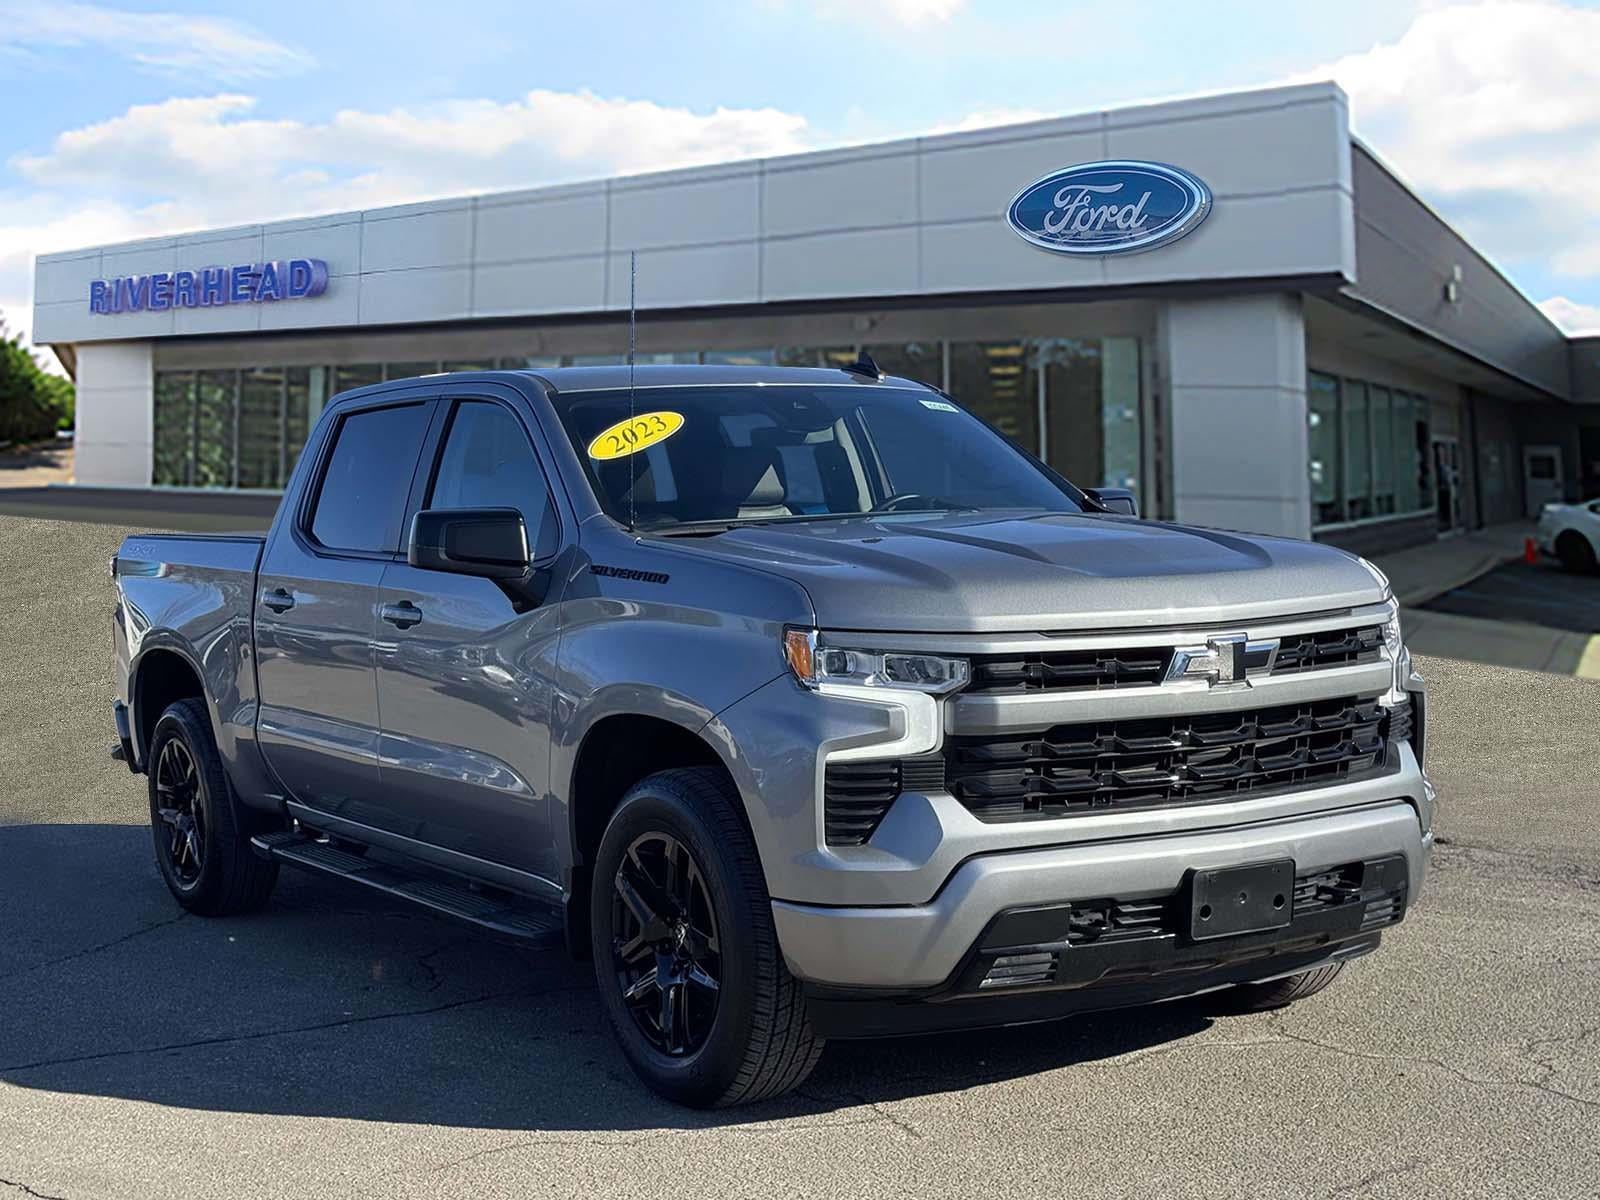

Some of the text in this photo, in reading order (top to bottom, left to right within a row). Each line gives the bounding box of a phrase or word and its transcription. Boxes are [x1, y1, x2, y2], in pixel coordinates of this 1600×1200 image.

[1043, 183, 1152, 233] Ford
[89, 259, 324, 314] RIVERHEAD
[606, 416, 667, 453] 2023
[589, 564, 670, 584] SILVERADO
